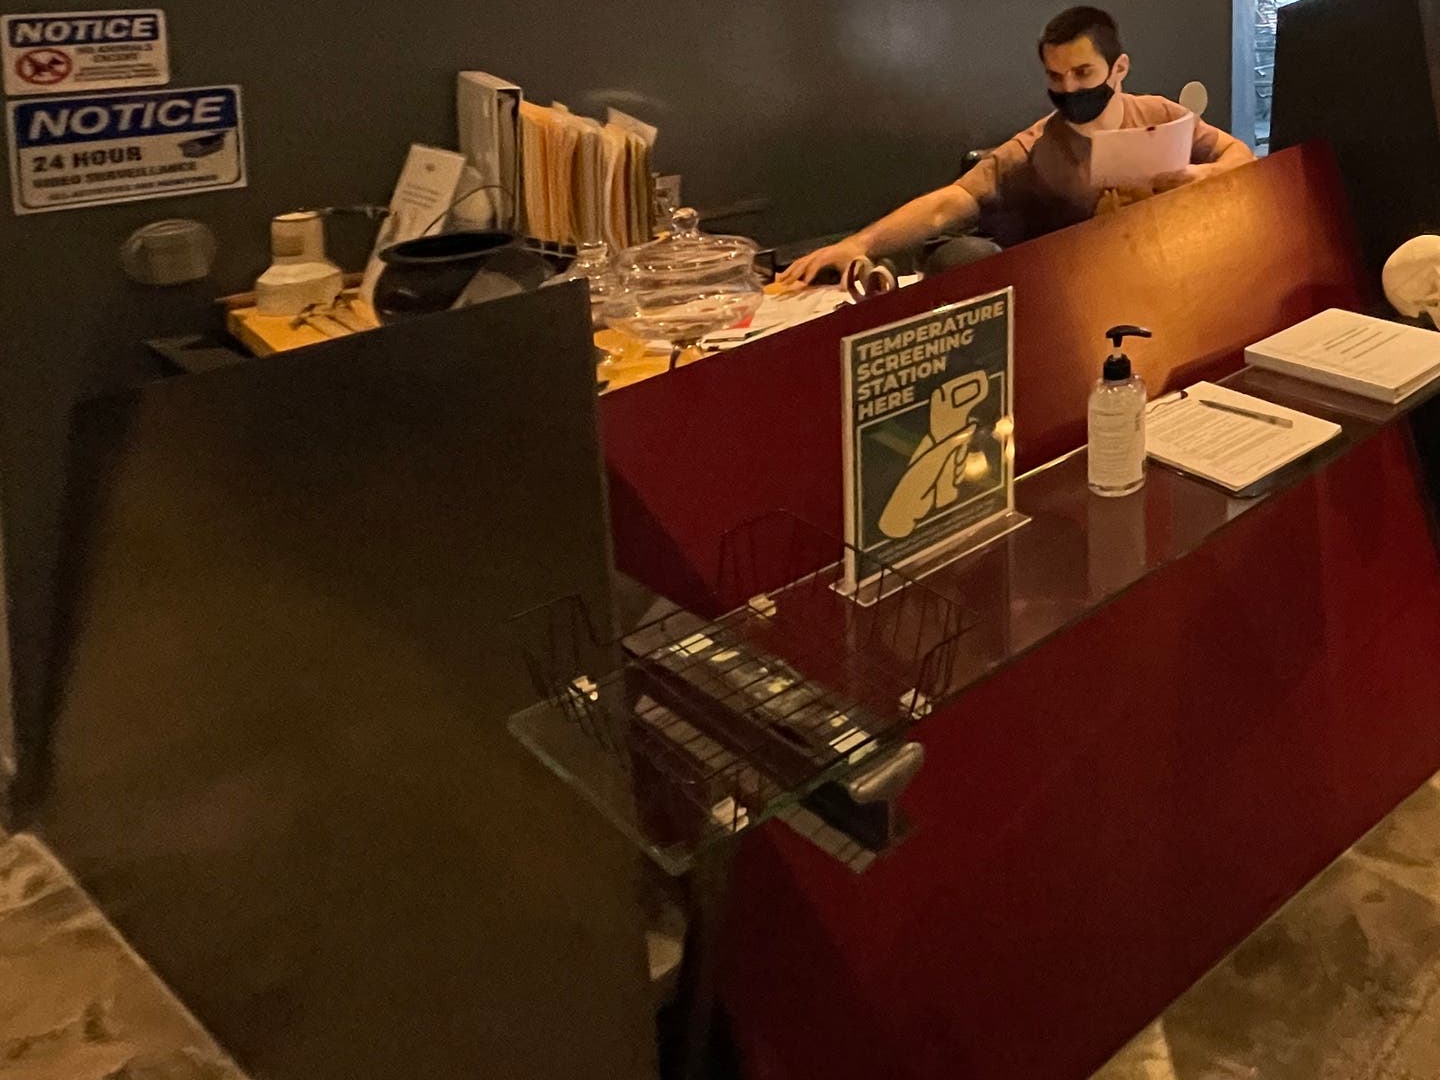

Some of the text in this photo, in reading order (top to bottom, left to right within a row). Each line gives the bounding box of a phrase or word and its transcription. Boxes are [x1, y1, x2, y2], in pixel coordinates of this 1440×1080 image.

[15, 17, 155, 43] NOTICE
[28, 95, 227, 140] NOTICE
[33, 146, 142, 172] 24 HOUR
[857, 301, 1005, 362] TEMPERATURE
[857, 329, 974, 382] SCREENING
[857, 356, 947, 402] STATION
[858, 386, 915, 421] HERE
